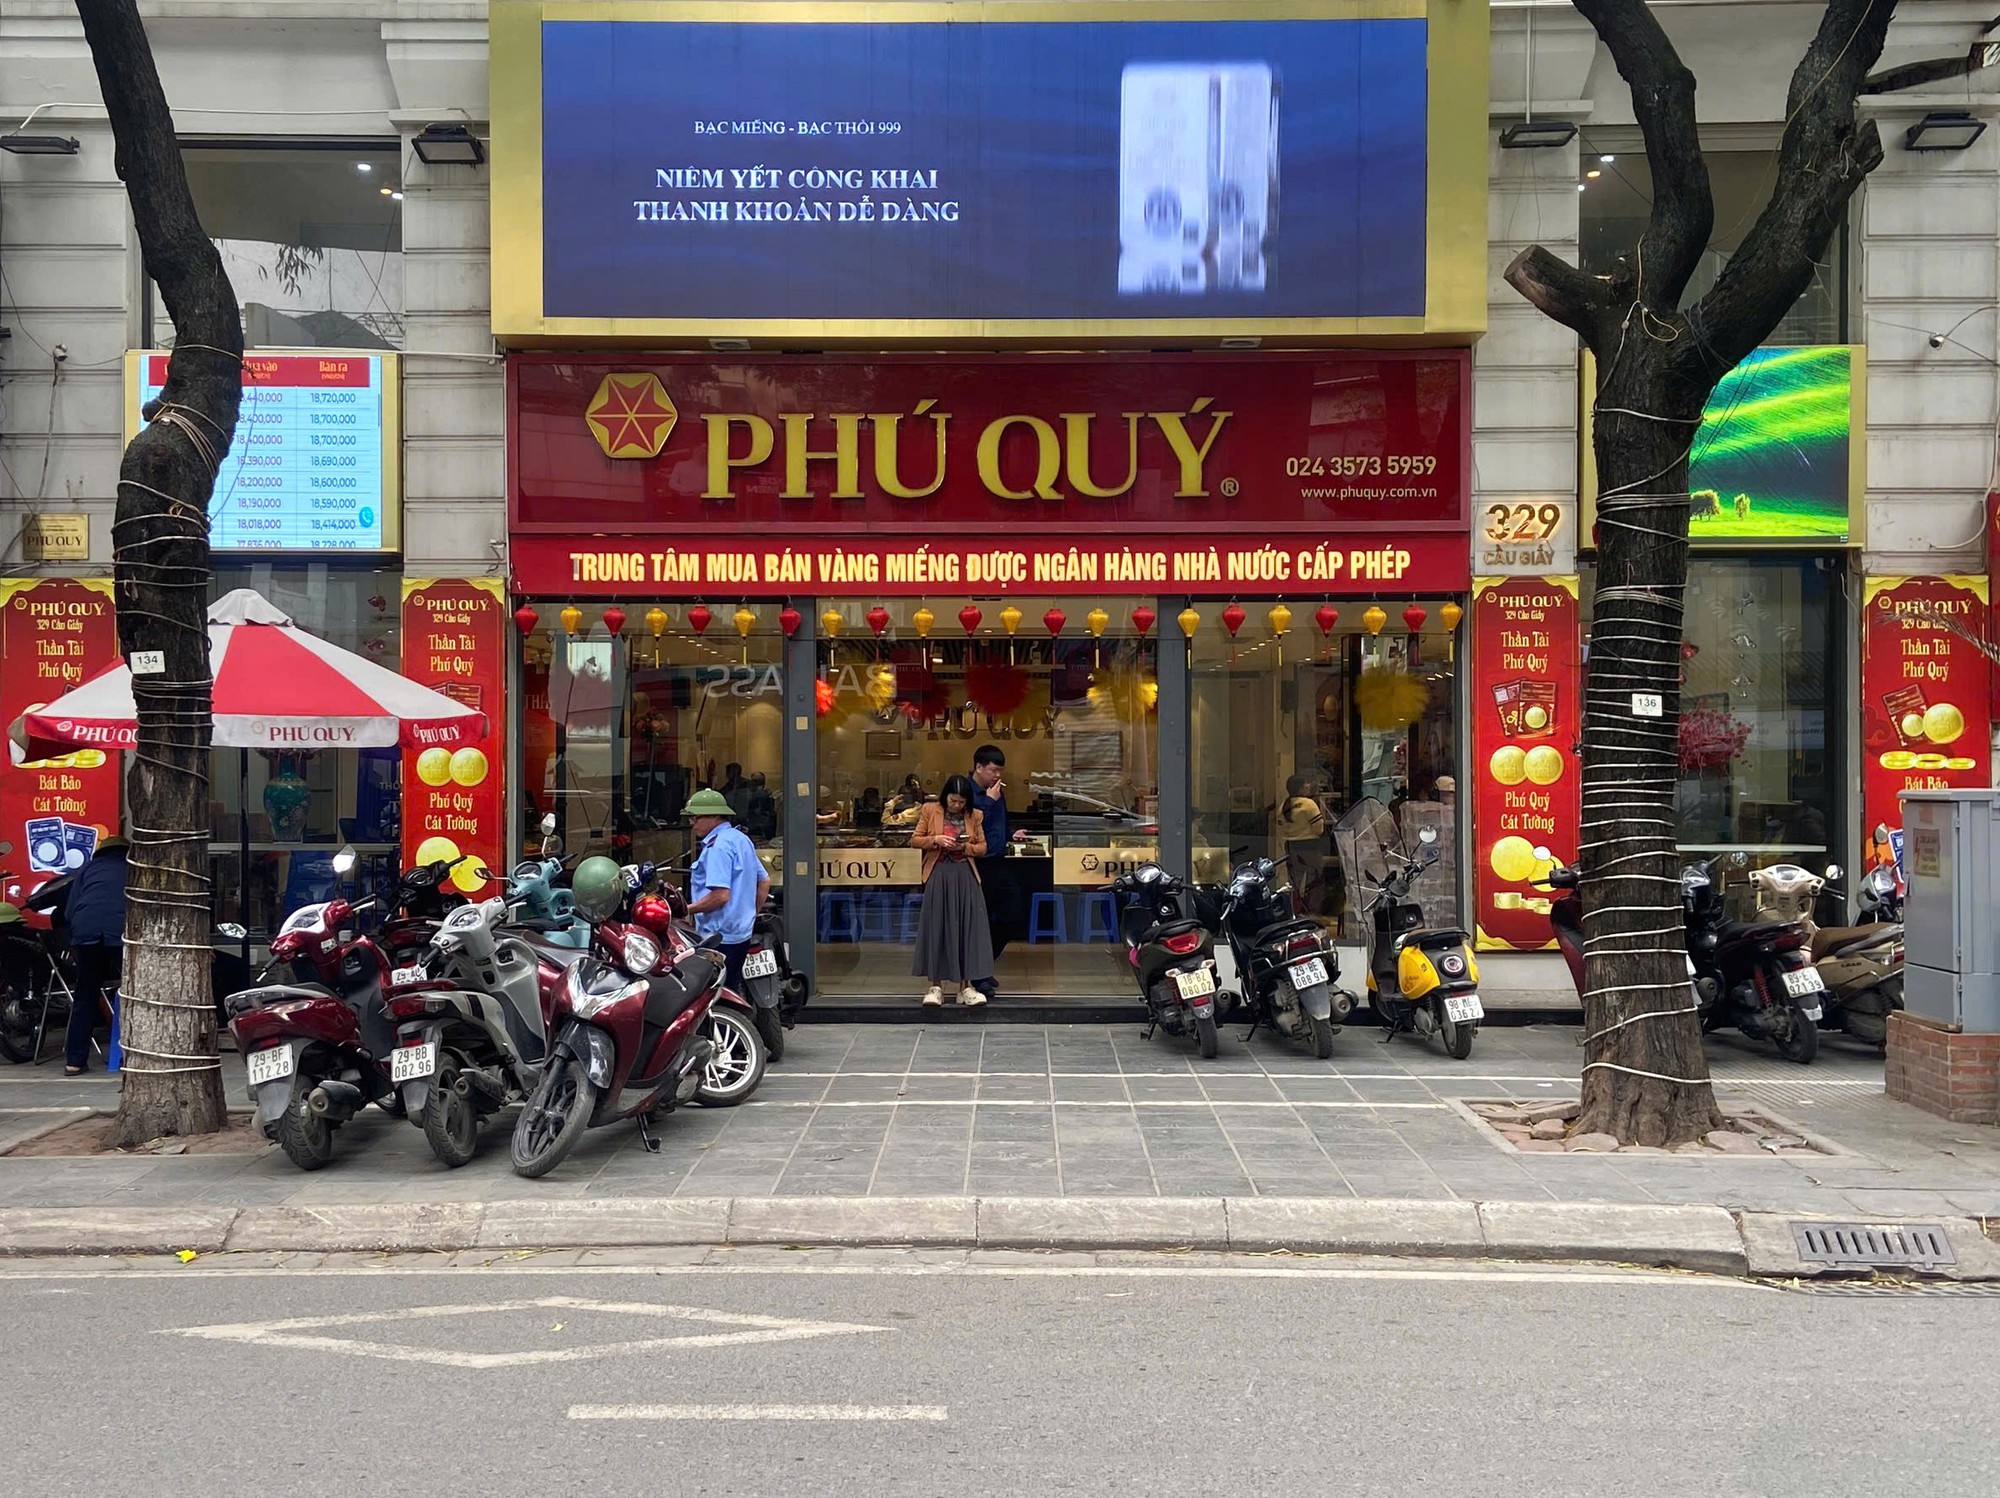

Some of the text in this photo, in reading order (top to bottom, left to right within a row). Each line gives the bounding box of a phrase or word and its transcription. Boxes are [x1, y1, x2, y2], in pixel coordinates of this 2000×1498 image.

[694, 121, 728, 135] BẠC
[731, 119, 785, 134] MIẾNG
[798, 121, 832, 135] BẠC
[878, 121, 901, 134] 999
[655, 164, 939, 189] NIÊM YẾT CÔNG KHAI
[633, 194, 959, 222] THANH KHOẢN DỄ DÀNG
[338, 363, 348, 372] ra
[311, 393, 355, 403] 18,720,000
[240, 414, 282, 424] 8,400,000
[311, 414, 356, 424] 18,700,000
[311, 435, 356, 445] 18,700,000
[700, 398, 953, 499] PHÚ
[975, 397, 1233, 500] QUÝ
[237, 456, 282, 466] 18,390,000
[311, 456, 356, 466] 18,690,000
[1286, 456, 1437, 477] 024 3573 5959
[237, 477, 282, 488] 18,200,000
[311, 477, 356, 488] 18,600,000
[1301, 484, 1438, 500] www.phuquy.com.vn
[238, 498, 281, 509] 18,190,000
[311, 498, 356, 509] 18,590,000
[237, 519, 281, 530] 18,018,000
[311, 519, 356, 530] 18,414,000
[1485, 504, 1560, 540] 329
[1484, 544, 1555, 565] CẦU GIẤY
[570, 541, 1411, 588] TRUNG TÂM MUA BÁN VÀNG MIẾNG ĐƯỢC NGÂN HÀNG NHÀ NƯỚC CẤP PHÉP
[30, 601, 104, 615] PHÚ QUÝ
[427, 598, 489, 611] PHÚ QUÝ
[1499, 594, 1563, 608] PHÚ QUÝ
[1934, 599, 1972, 614] QUÝ
[36, 639, 84, 656] Thần Tài
[428, 633, 476, 650] Thần Tài
[1500, 631, 1550, 648] Thần Tài
[1900, 637, 1950, 655] Thần Tài
[137, 655, 158, 665] 134
[430, 656, 474, 677] Phú Quý
[1503, 653, 1549, 674] Phú Quý
[38, 662, 83, 682] Phú Quý
[1903, 661, 1949, 681] Phú Quý
[1638, 698, 1657, 707] 136
[72, 725, 116, 743] PHÚ
[269, 725, 354, 742] PHÚ QUÝ
[420, 725, 438, 743] PHÚ
[39, 775, 81, 790] Bát Bảo
[33, 796, 86, 816] Cát Tường
[430, 792, 473, 813] Phú Quý
[1505, 791, 1550, 811] Phú Quý
[425, 814, 478, 835] Cát Tường
[1500, 813, 1555, 833] Cát Tường
[847, 859, 896, 878] QUÝ
[254, 1048, 283, 1067] 29-BF
[398, 1046, 427, 1064] 29-BB
[253, 1061, 289, 1081] 112.28
[395, 1060, 431, 1078] 082.96
